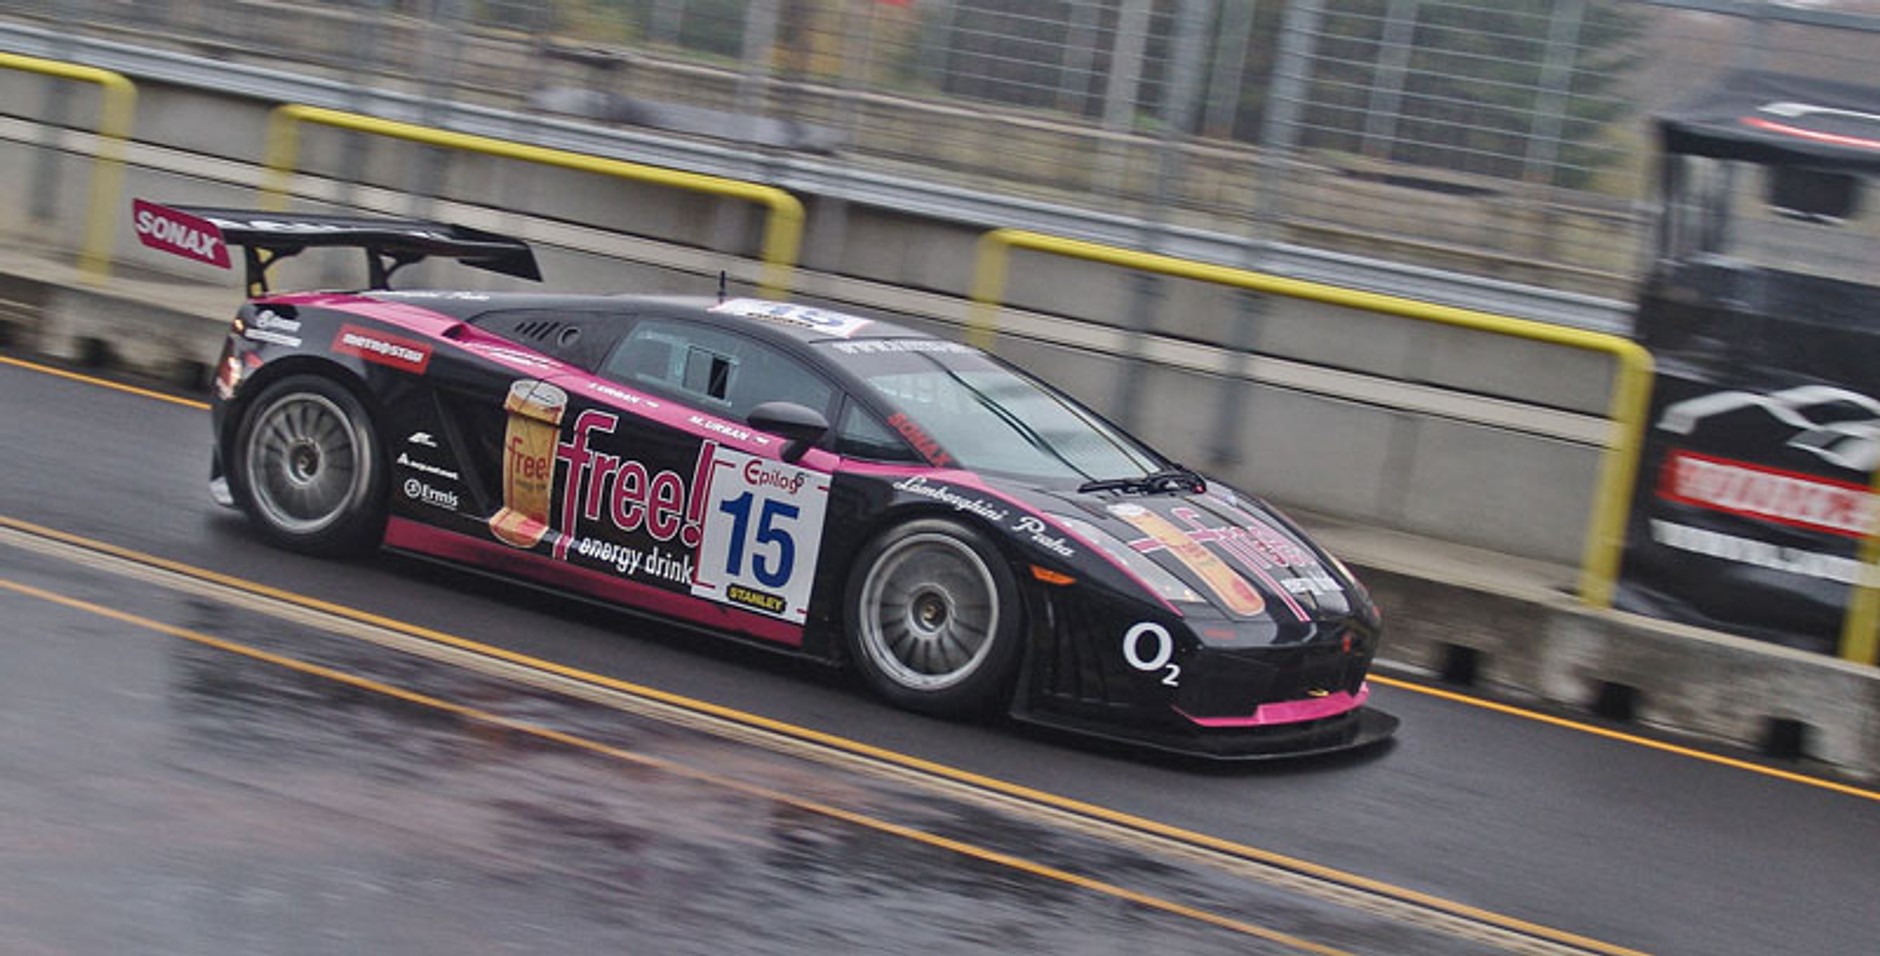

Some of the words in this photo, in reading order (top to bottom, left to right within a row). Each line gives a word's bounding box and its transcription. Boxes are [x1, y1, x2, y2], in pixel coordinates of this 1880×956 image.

[136, 211, 217, 260] SONAX
[552, 408, 720, 561] free!
[893, 475, 1008, 521] Lamborghini
[1012, 516, 1075, 557] Praha
[578, 537, 642, 574] energy
[645, 546, 695, 584] drink
[719, 491, 800, 588] 15
[729, 587, 783, 610] STANLEY
